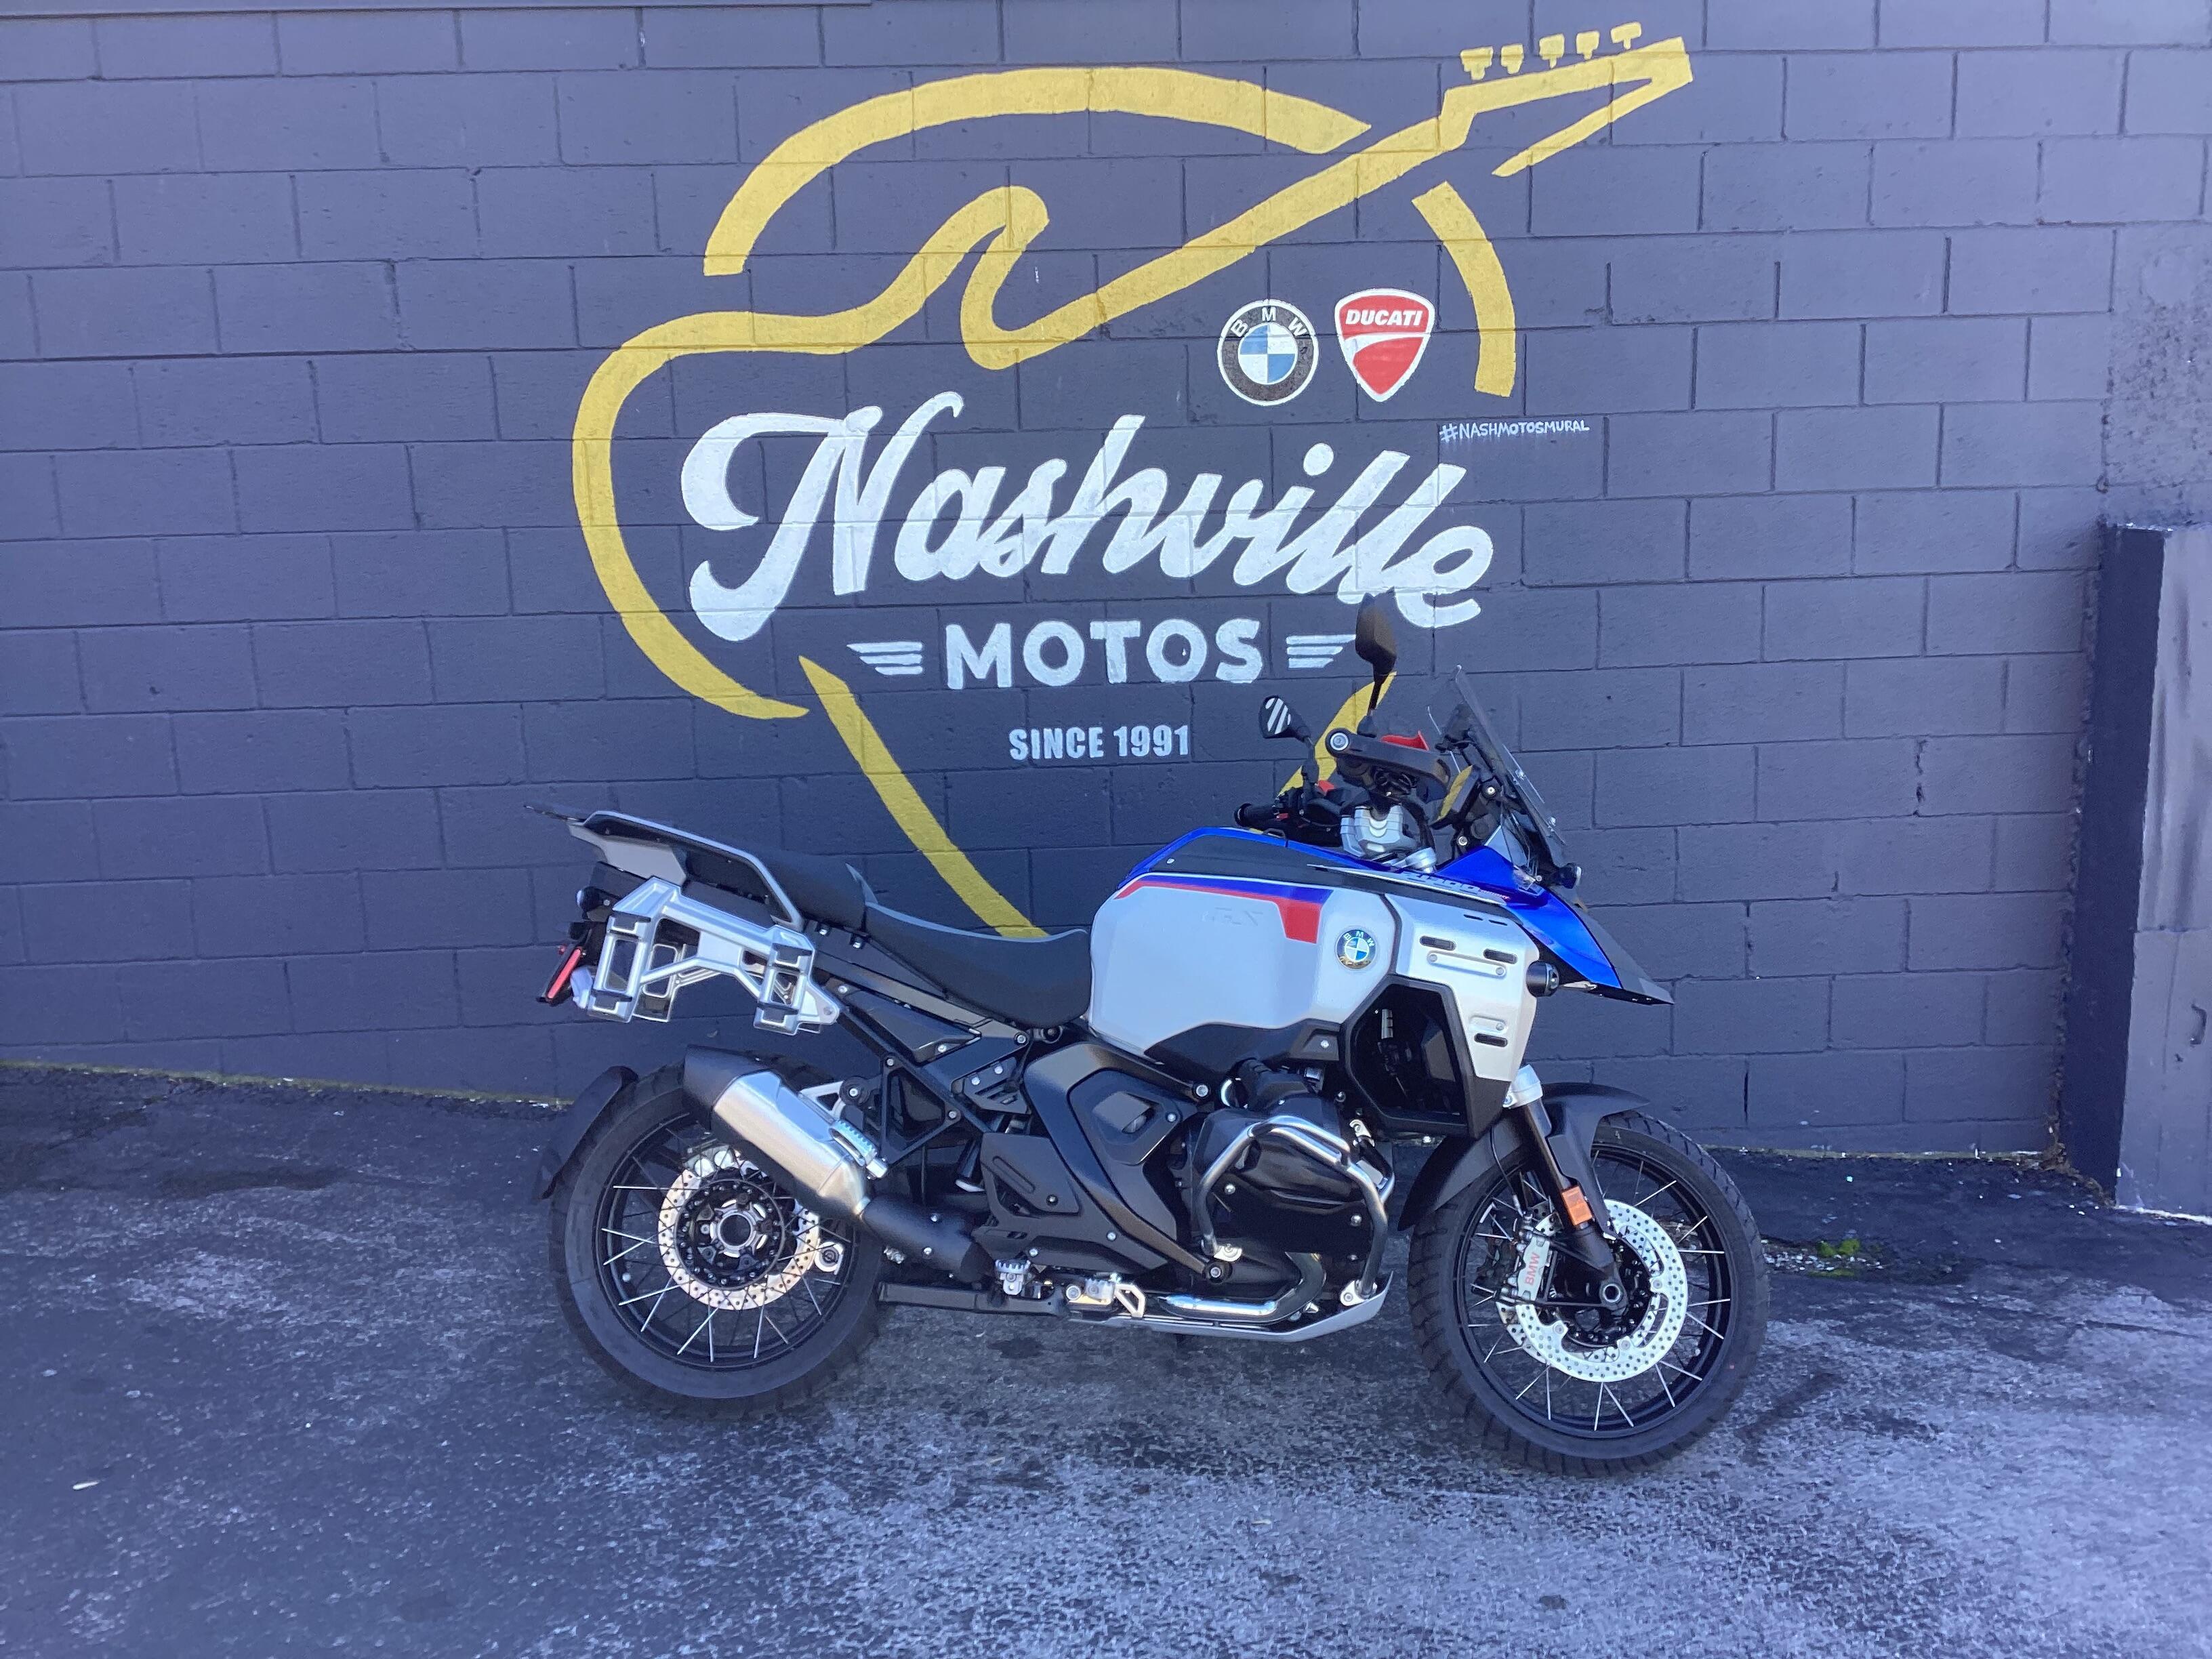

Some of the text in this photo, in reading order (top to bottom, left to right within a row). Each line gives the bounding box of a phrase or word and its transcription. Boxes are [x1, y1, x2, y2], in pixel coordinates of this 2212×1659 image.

[1230, 306, 1307, 337] BMW
[1345, 309, 1422, 326] DUCATI
[1439, 419, 1591, 443] #NASHMOTOSMURAL
[680, 391, 1494, 642] Nashville
[945, 618, 1263, 690] MOTOS
[1008, 724, 1189, 760] SINCE 1991
[1343, 930, 1375, 947] BMW
[1525, 1252, 1540, 1286] BMW
